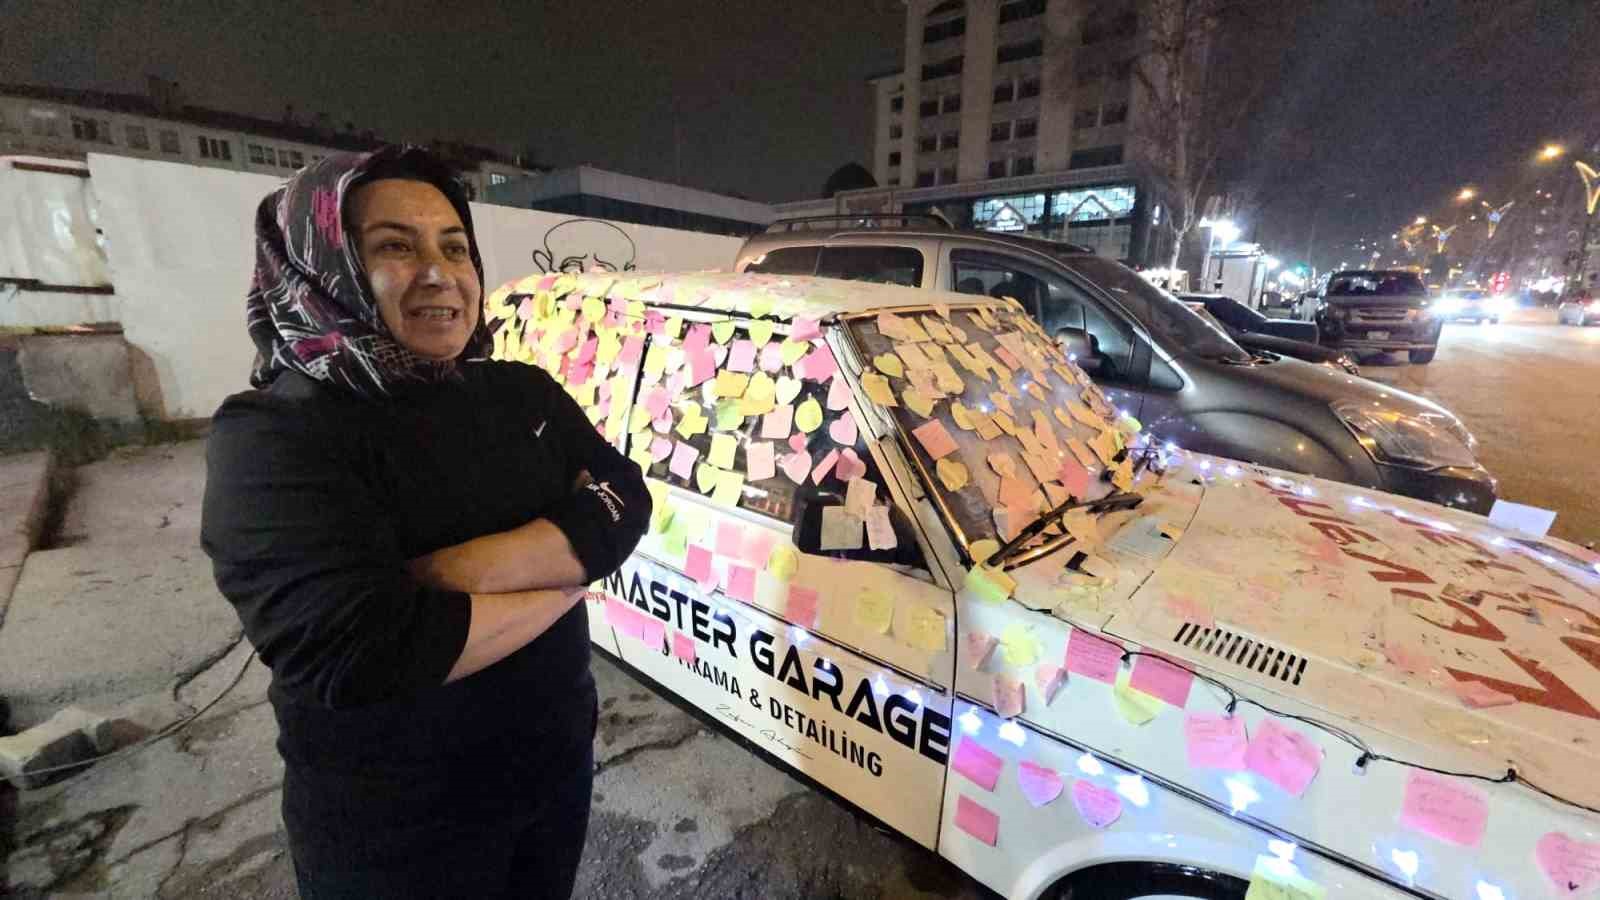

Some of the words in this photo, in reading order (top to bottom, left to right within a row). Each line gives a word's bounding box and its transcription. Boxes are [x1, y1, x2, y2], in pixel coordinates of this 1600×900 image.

[597, 491, 622, 522] JORDAN
[603, 567, 738, 659] MASTER
[749, 629, 951, 766] GARAGE
[678, 648, 742, 703] KAMA
[749, 687, 763, 710] &
